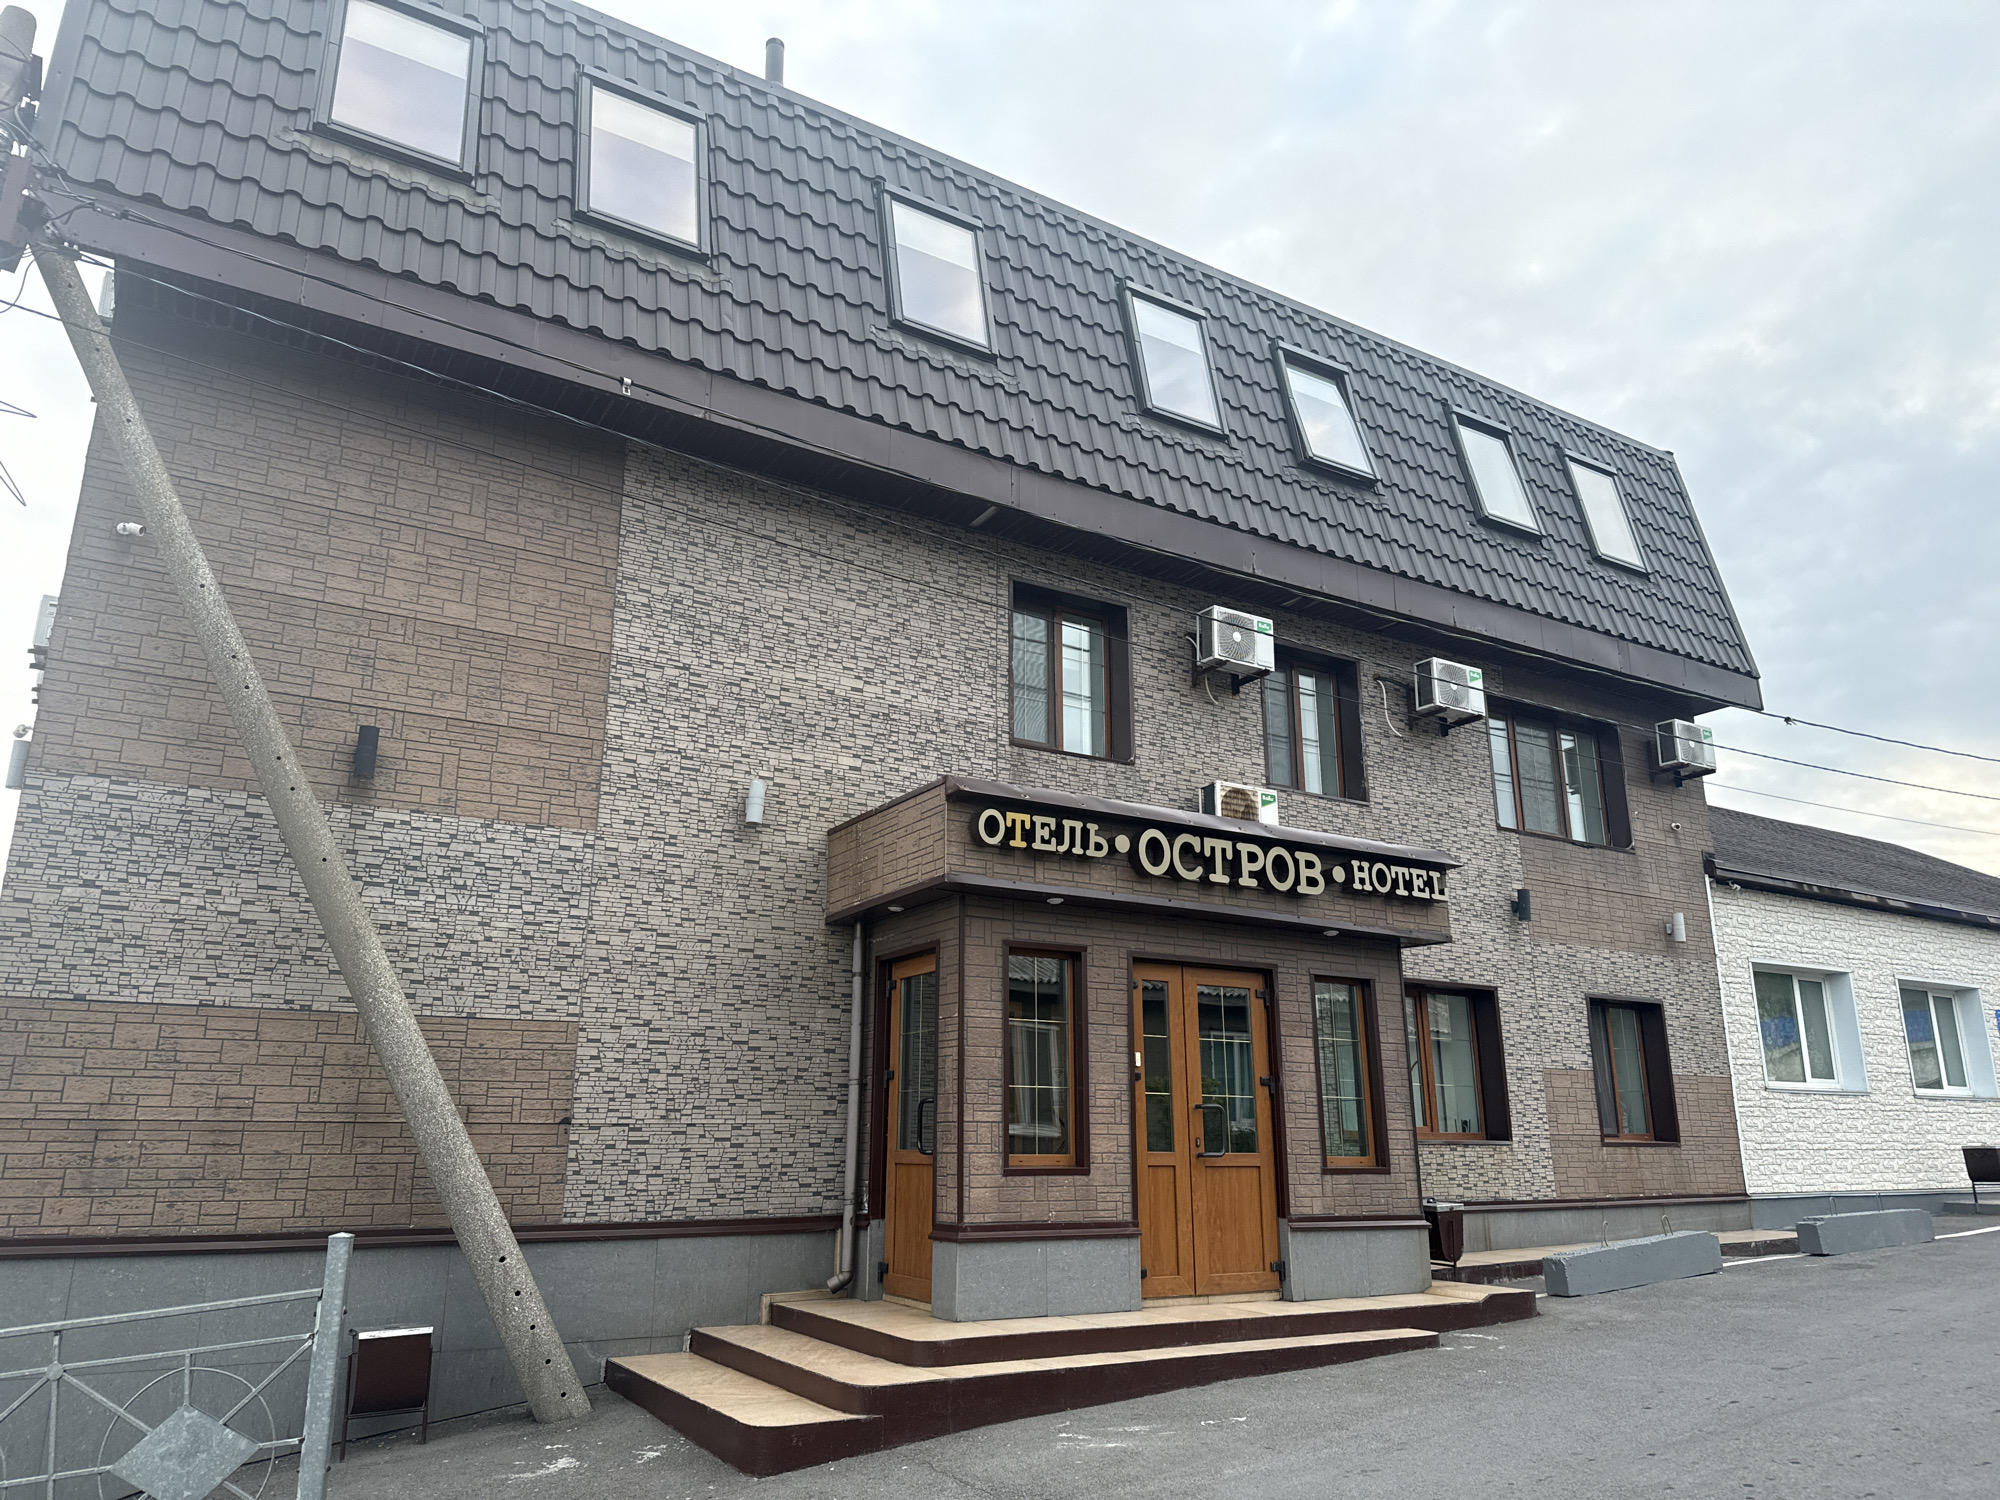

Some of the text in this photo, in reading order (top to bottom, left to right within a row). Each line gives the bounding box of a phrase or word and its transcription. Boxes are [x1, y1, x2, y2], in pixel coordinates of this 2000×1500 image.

[978, 808, 1449, 900] ОТЕЛЬ ОСТРОВ HOTEL
